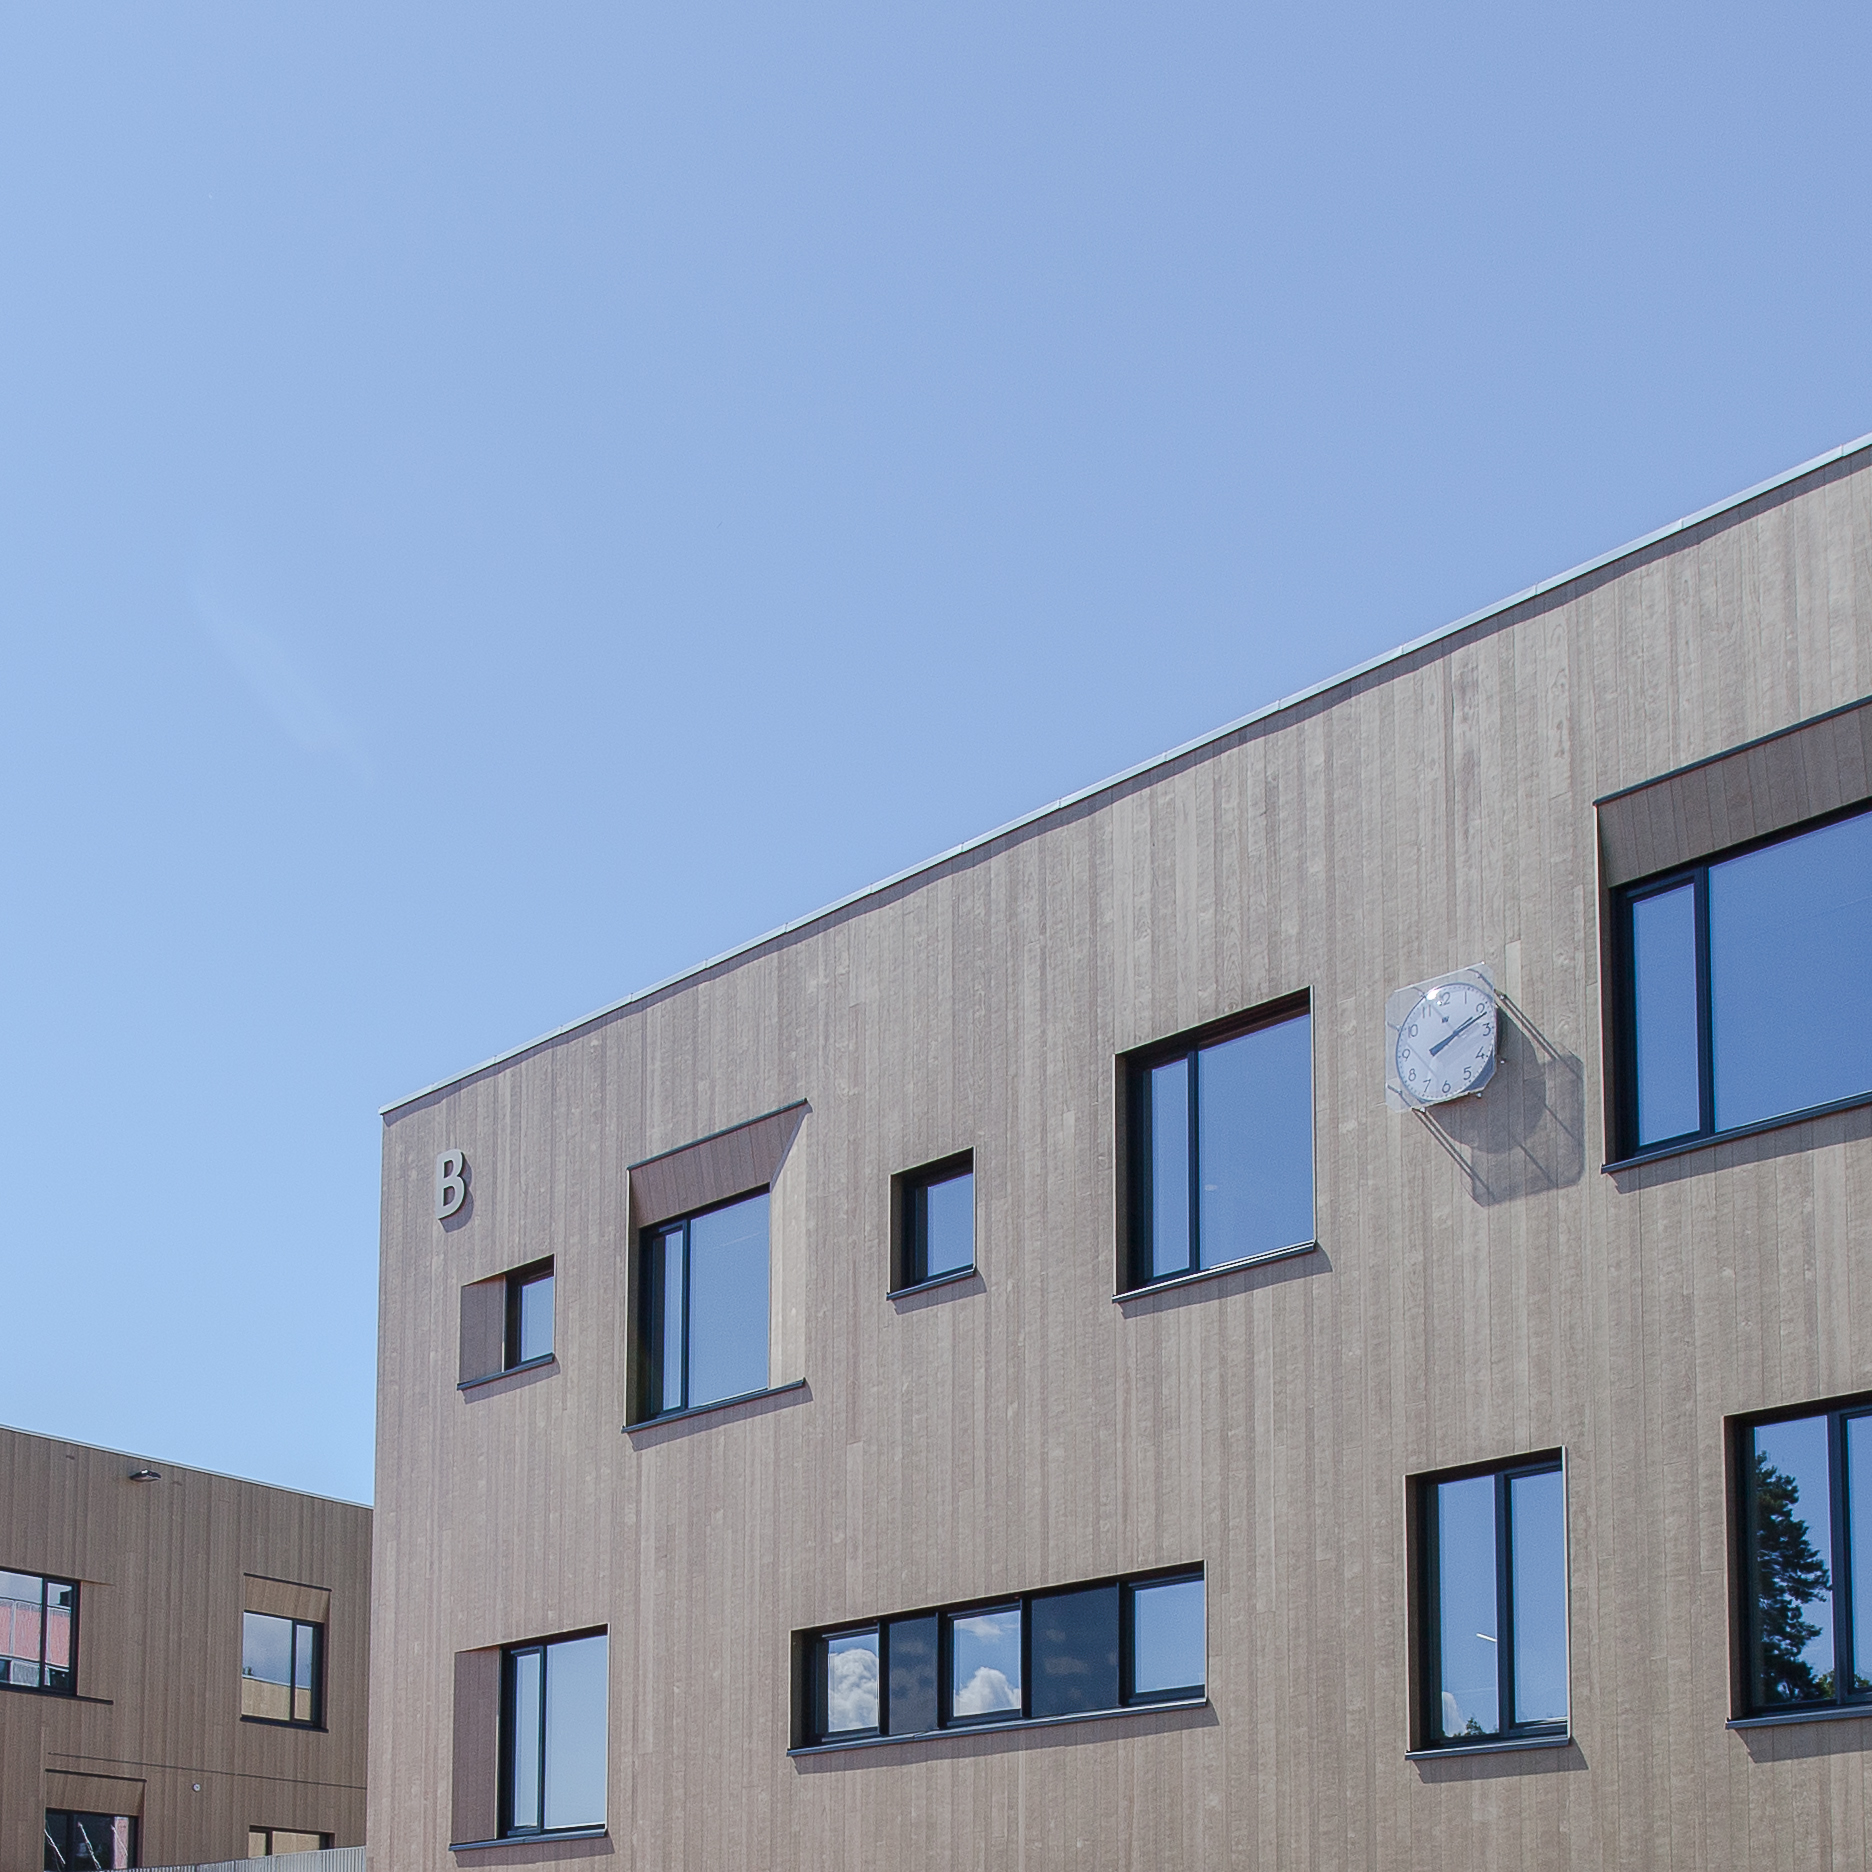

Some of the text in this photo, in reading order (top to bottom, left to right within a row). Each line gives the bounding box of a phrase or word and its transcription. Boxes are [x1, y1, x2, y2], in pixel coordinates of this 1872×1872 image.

[1464, 991, 1467, 1004] 1
[1423, 1004, 1431, 1018] 11
[1483, 1023, 1491, 1036] 3
[1402, 1049, 1411, 1061] 9
[1476, 1046, 1485, 1059] 4
[1408, 1068, 1417, 1081] 8
[1463, 1066, 1472, 1080] 5
[1423, 1079, 1431, 1093] 7
[1442, 1080, 1451, 1093] 6
[434, 1150, 465, 1220] B
